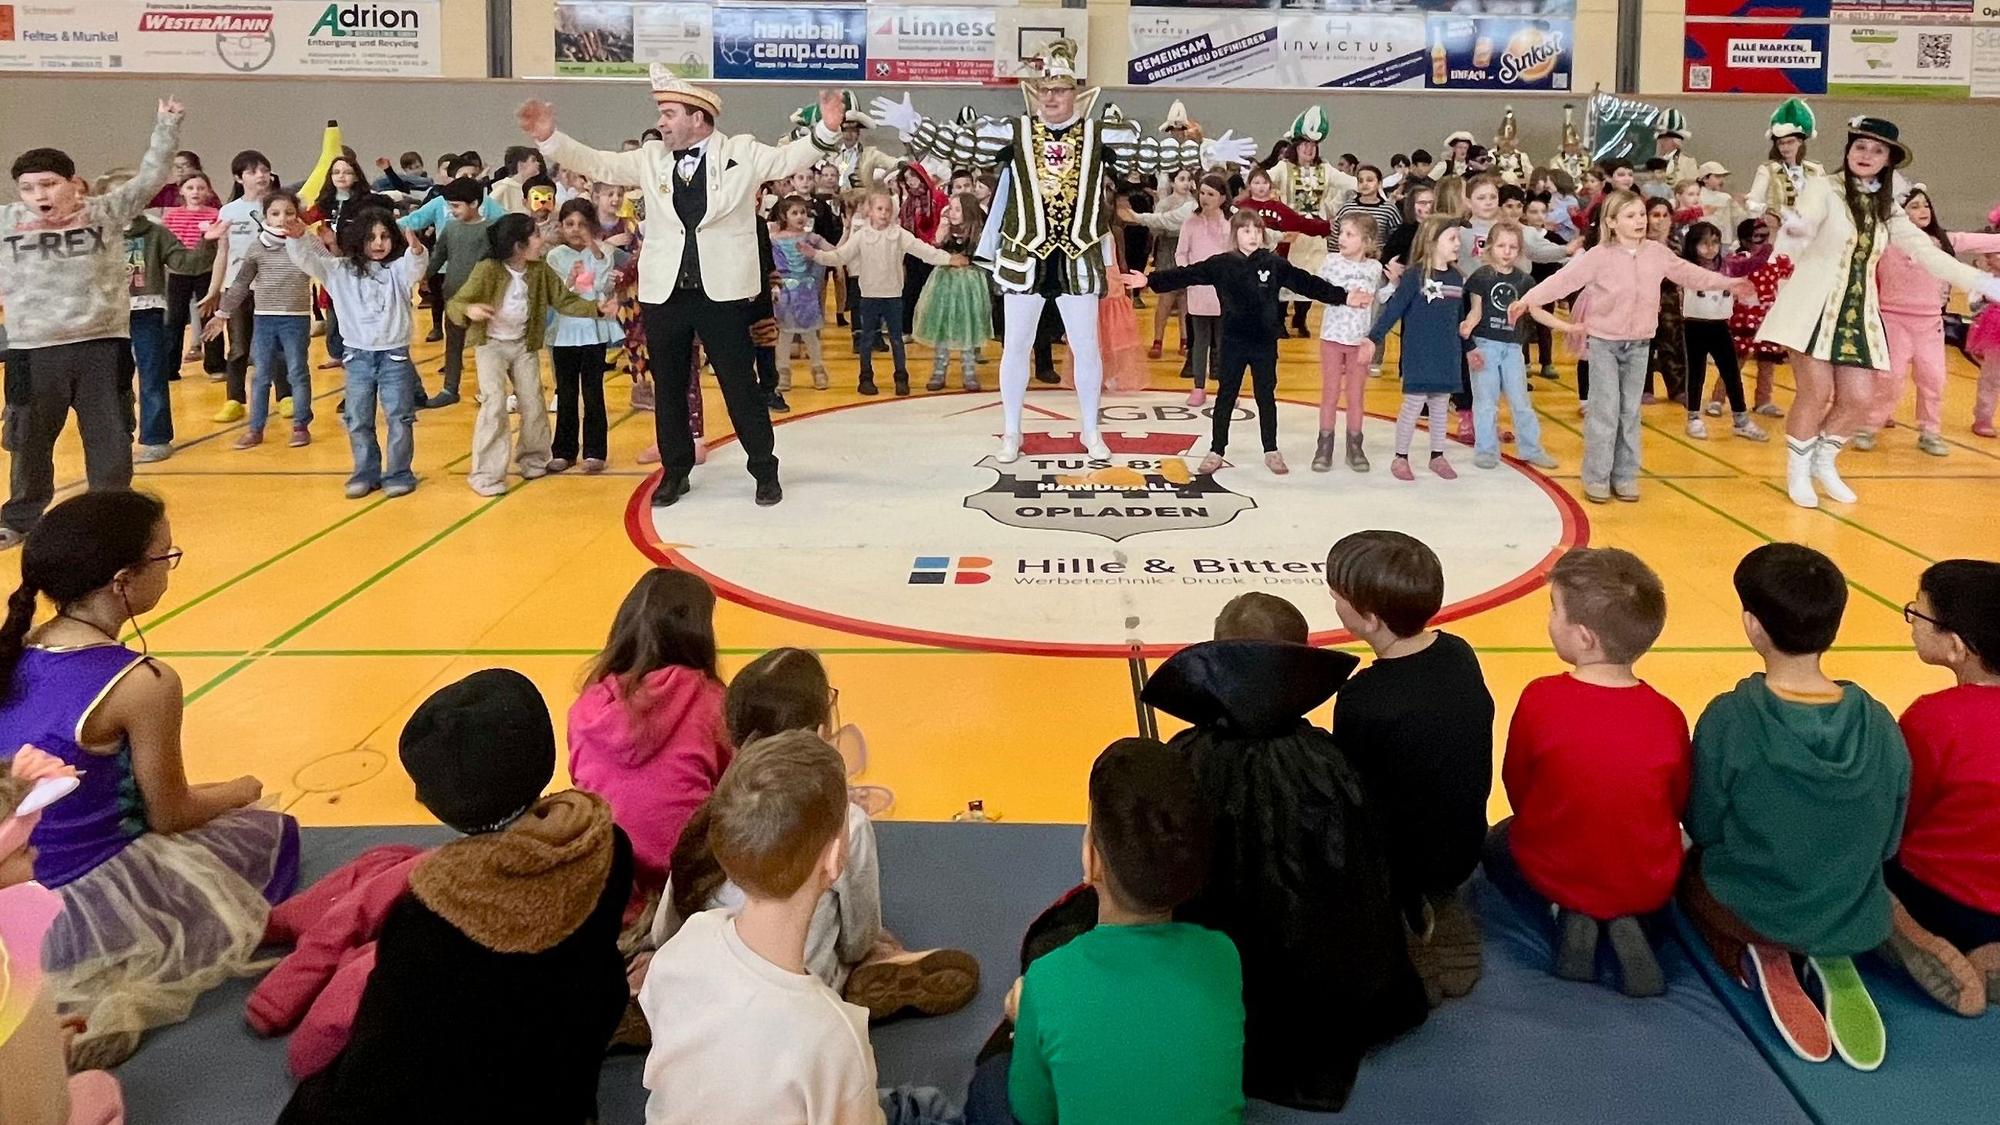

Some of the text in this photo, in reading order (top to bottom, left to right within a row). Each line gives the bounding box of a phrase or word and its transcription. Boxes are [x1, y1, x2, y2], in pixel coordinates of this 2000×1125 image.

[308, 4, 418, 37] Adrion
[61, 31, 70, 42] &
[73, 31, 119, 42] Munkel
[307, 39, 419, 48] Entsorgung und Recycling
[753, 43, 860, 62] camp.com
[1732, 43, 1807, 52] ALLE MARKEN,
[1134, 38, 1208, 73] GEMEINSAM
[1148, 61, 1192, 81] GRENZEN
[1191, 54, 1212, 67] NEU
[1212, 32, 1267, 60] DEFINIEREN
[1500, 31, 1563, 83] Sunkist
[1732, 55, 1817, 64] EINE WERKSTATT
[4, 226, 107, 263] T-REX
[1030, 459, 1113, 470] TUS
[1015, 506, 1210, 518] OPLADEN
[1017, 558, 1127, 574] Hille
[1143, 558, 1177, 574] &
[1014, 577, 1325, 587] Werbetechnik Druck Desig
